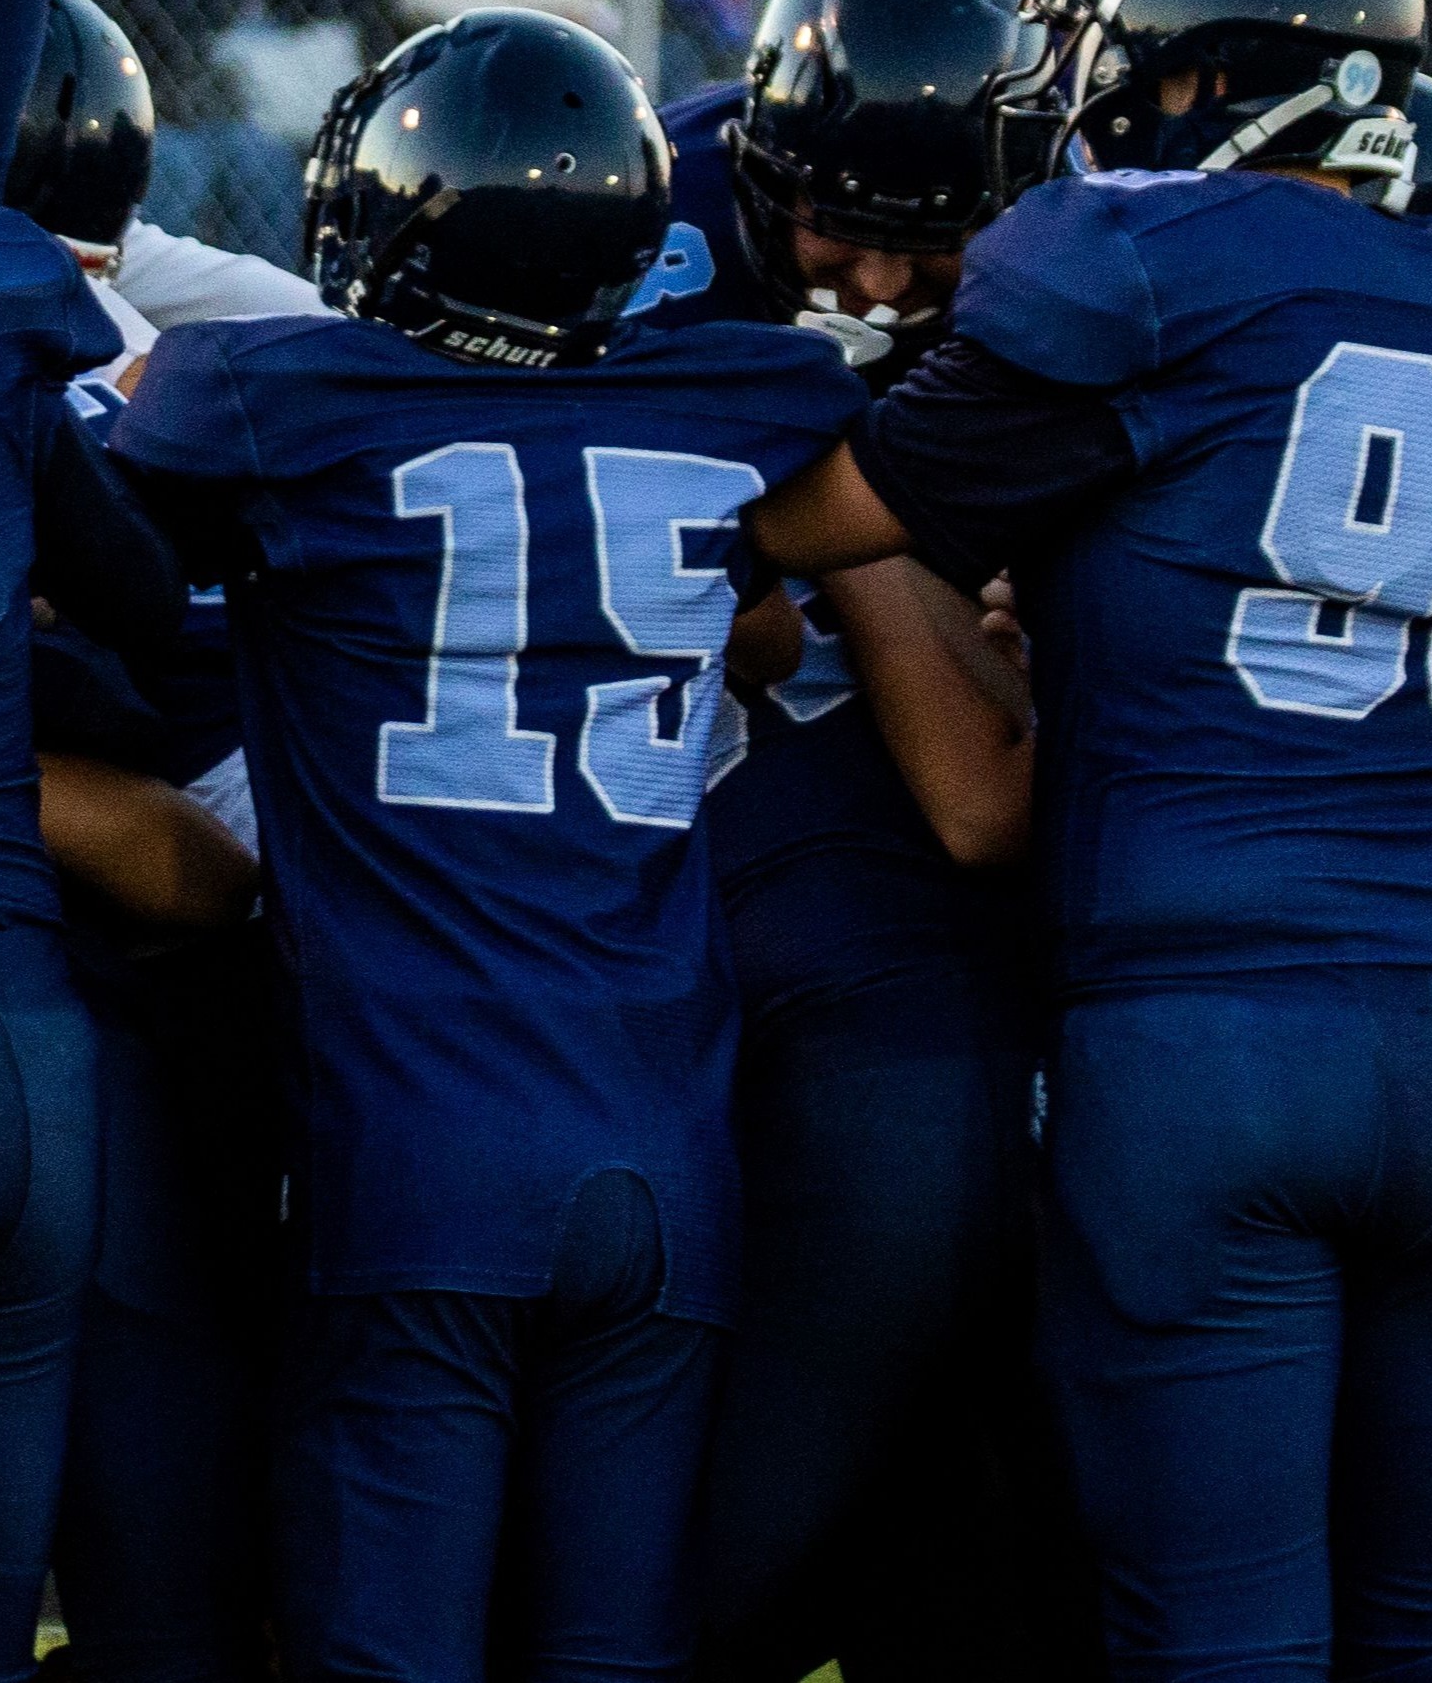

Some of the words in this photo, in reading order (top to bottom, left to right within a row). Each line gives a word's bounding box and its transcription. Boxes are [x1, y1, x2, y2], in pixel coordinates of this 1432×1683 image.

[1357, 129, 1407, 160] schu
[442, 329, 559, 368] schutt
[377, 441, 766, 830] 15
